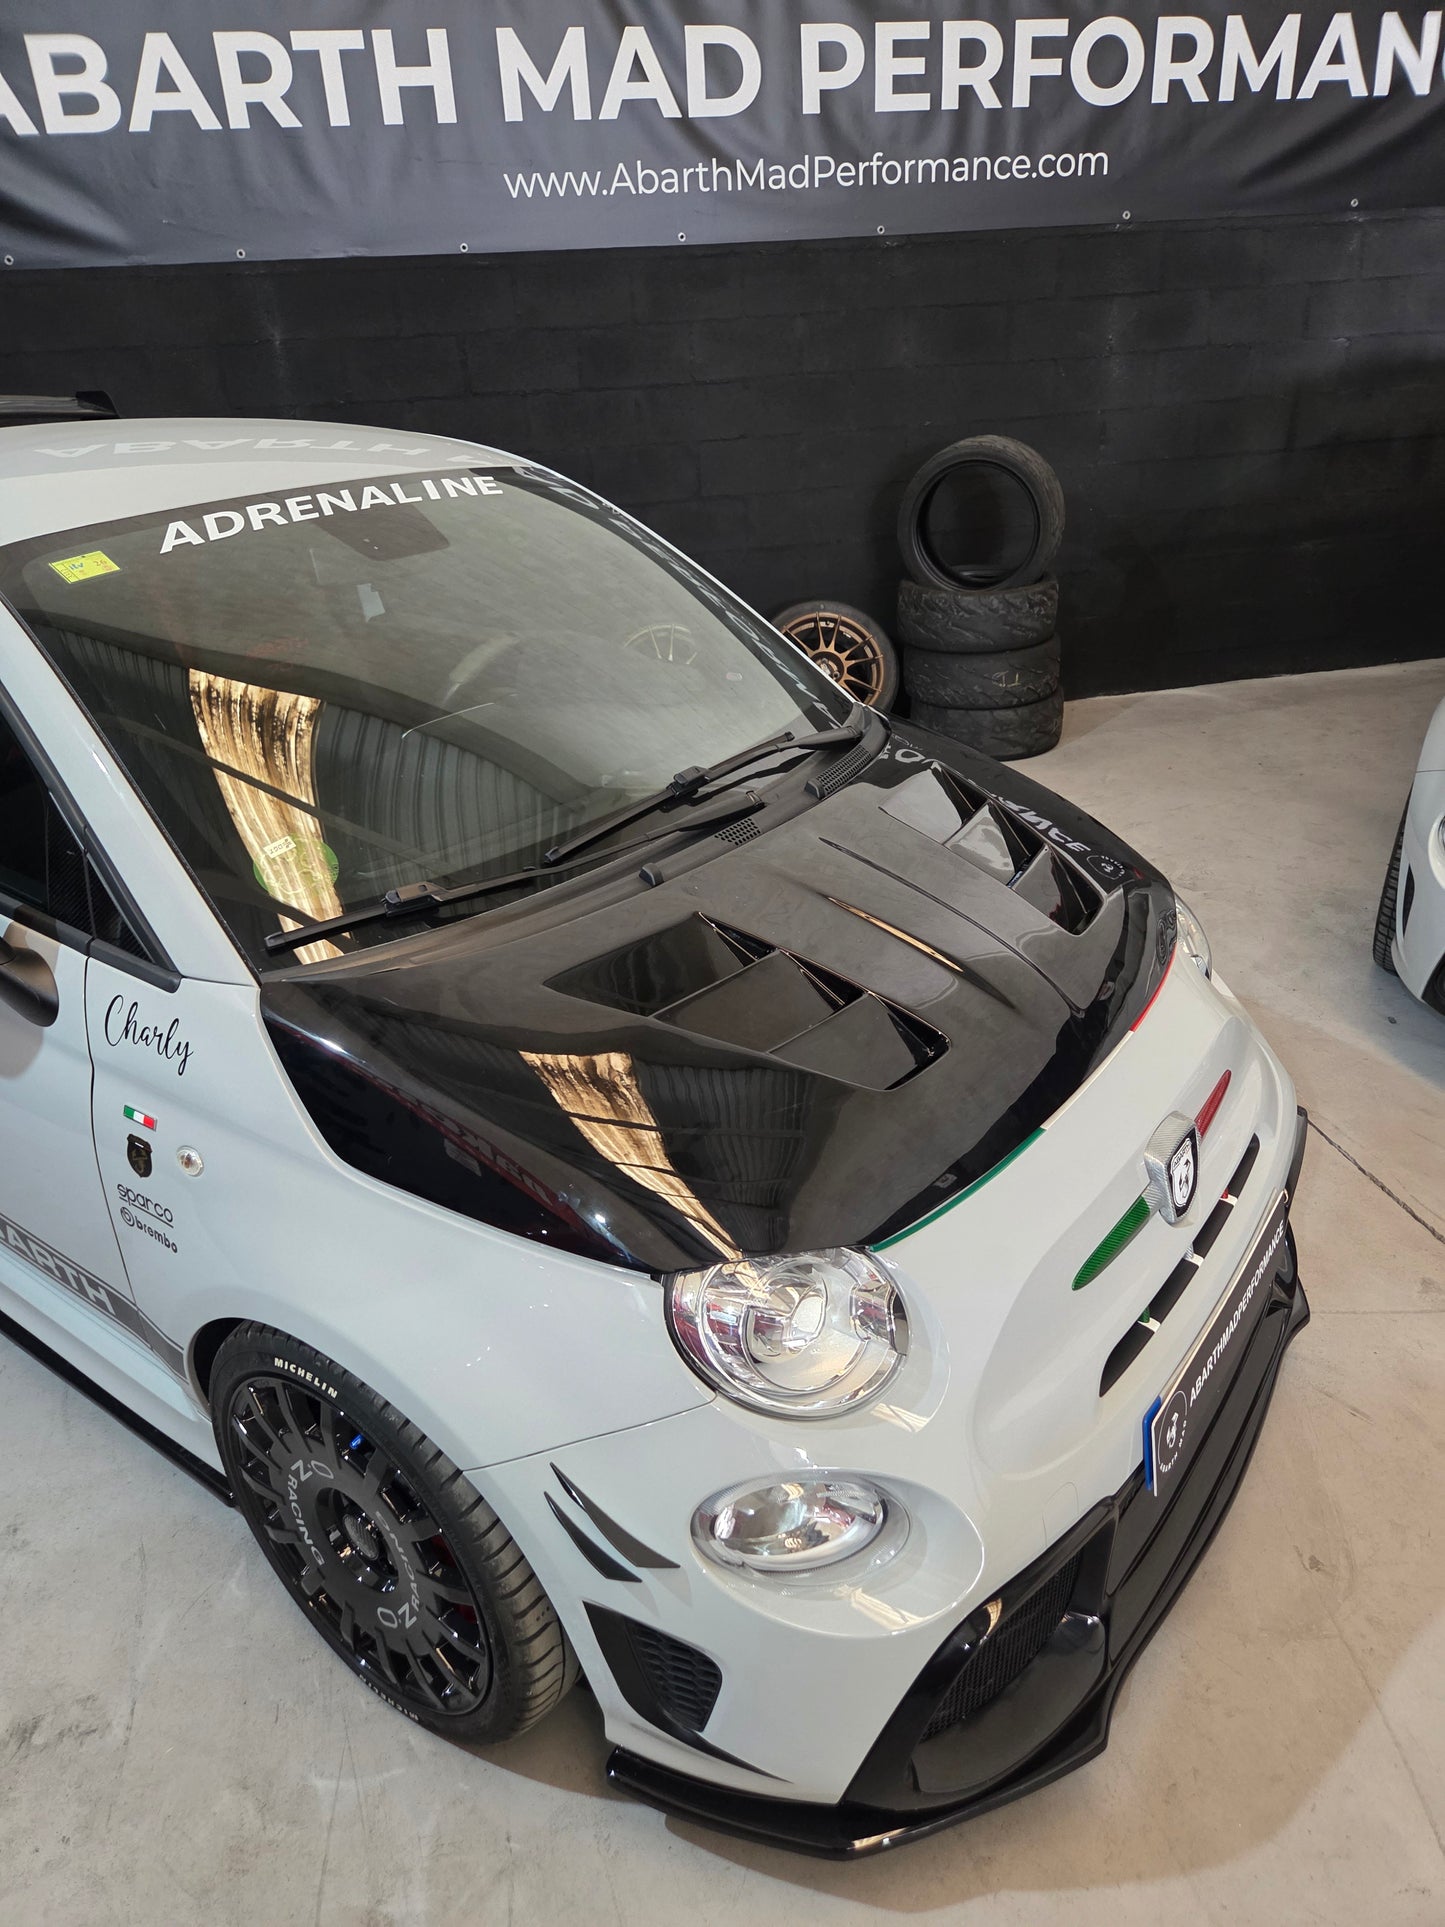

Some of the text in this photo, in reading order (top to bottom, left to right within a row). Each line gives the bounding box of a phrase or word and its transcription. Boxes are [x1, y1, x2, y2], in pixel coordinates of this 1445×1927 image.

[496, 25, 761, 122] MAD
[800, 10, 1445, 114] PERFORMAN
[503, 151, 1109, 198] www.AbarthMadPerformance.com
[160, 476, 503, 554] ADRENALINE
[104, 994, 194, 1076] Charly
[117, 1183, 173, 1224] sparco
[136, 1219, 178, 1254] brembo
[0, 1224, 116, 1316] ARTH
[1190, 1219, 1284, 1407] ABARTHMADPERFORMANCE
[274, 1357, 338, 1399] MICHELIN
[287, 1474, 324, 1566] RACING
[376, 1511, 419, 1612] RACING
